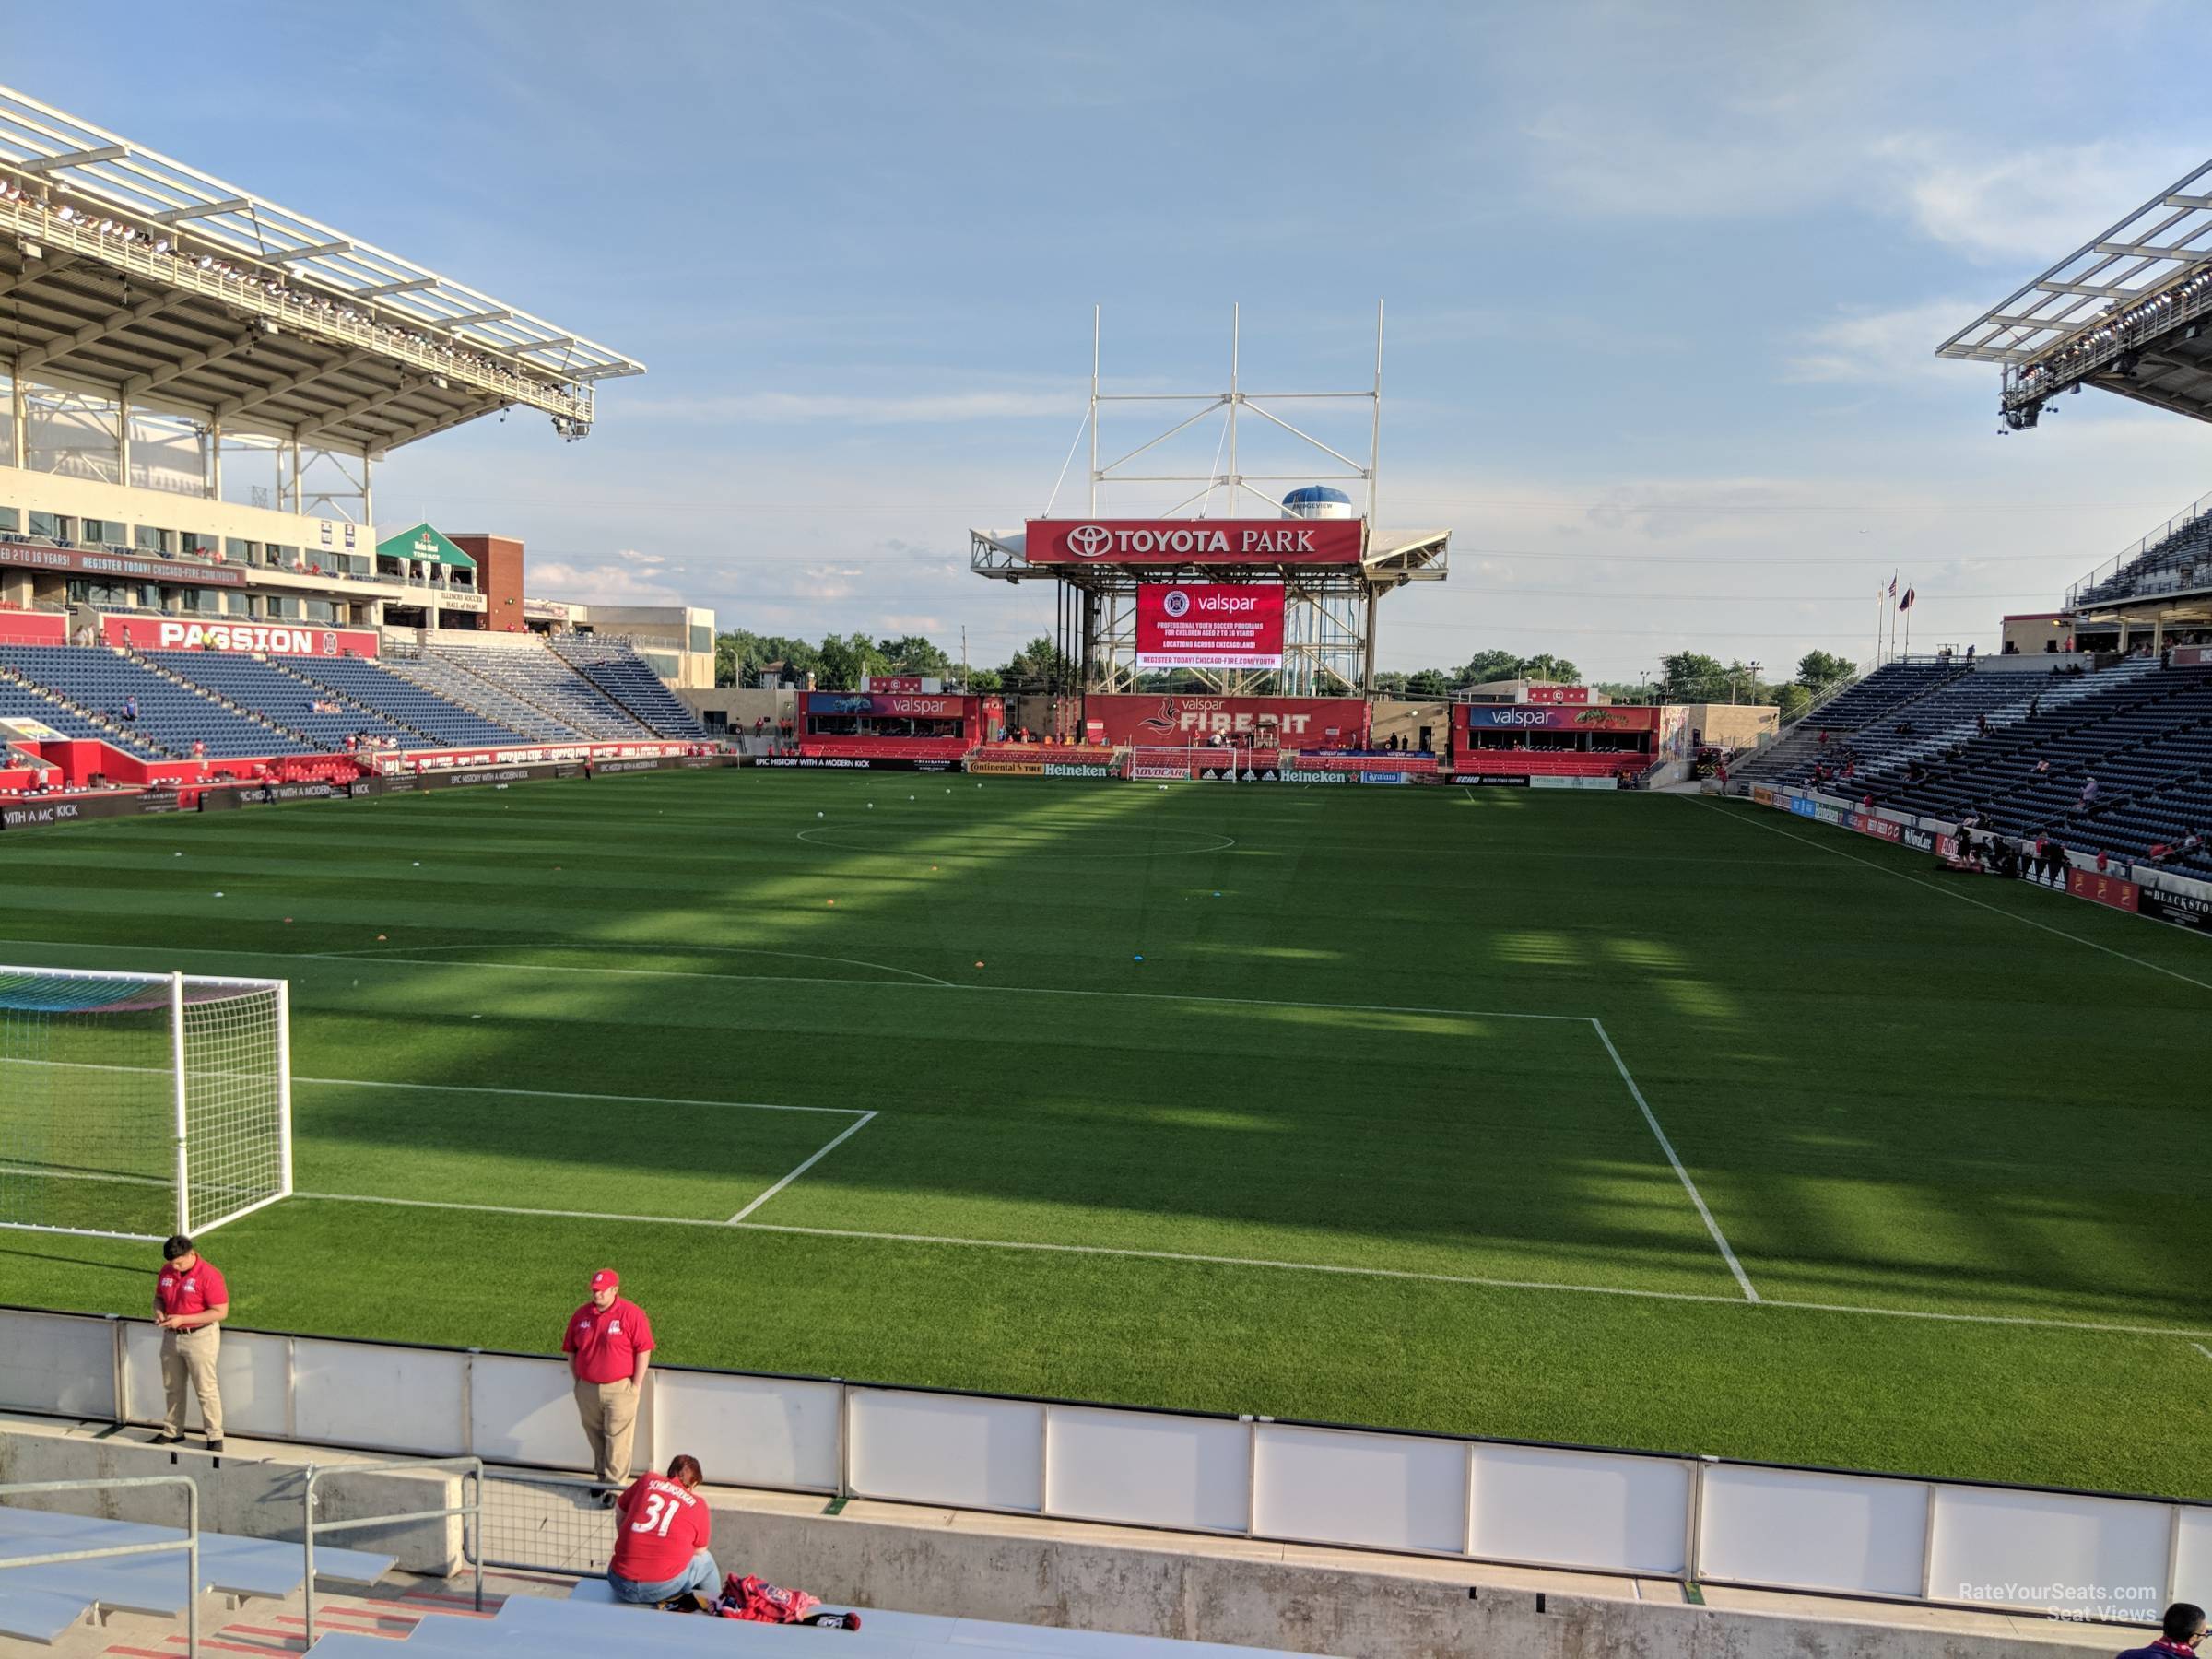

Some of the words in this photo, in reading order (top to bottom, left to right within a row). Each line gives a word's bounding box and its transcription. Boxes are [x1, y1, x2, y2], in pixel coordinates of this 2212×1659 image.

[1115, 530, 1230, 553] TOYOTA
[1241, 530, 1315, 552] PARK
[13, 549, 18, 561] 2
[20, 550, 29, 562] TO
[44, 553, 70, 566] YEARS!
[83, 557, 122, 571] REGISTER
[124, 561, 150, 574] TODAY!
[441, 592, 463, 601] ILLINOIS
[465, 594, 483, 603] SOCCER
[1198, 593, 1258, 614] valspar
[160, 623, 312, 653] PASSION
[893, 697, 947, 715] valspar
[1182, 698, 1225, 713] valspar
[1491, 707, 1554, 727] valspar
[799, 759, 818, 767] WITH
[825, 759, 854, 768] MODERN
[854, 759, 870, 768] KICK
[971, 762, 1014, 772] Continental
[1045, 764, 1107, 777] Heineken
[451, 775, 462, 784] EPIC
[462, 773, 481, 783] HISTORY
[482, 772, 494, 782] WITH
[500, 771, 518, 780] MODERN
[1280, 771, 1346, 782] Heineken
[252, 789, 278, 801] HISTRY
[279, 788, 297, 798] WITH
[298, 787, 304, 796] A
[29, 810, 36, 821] A
[57, 805, 78, 818] KICK
[1909, 830, 1932, 850] NovaCare
[2154, 890, 2211, 913] BLACKSTO
[631, 1493, 680, 1537] 31
